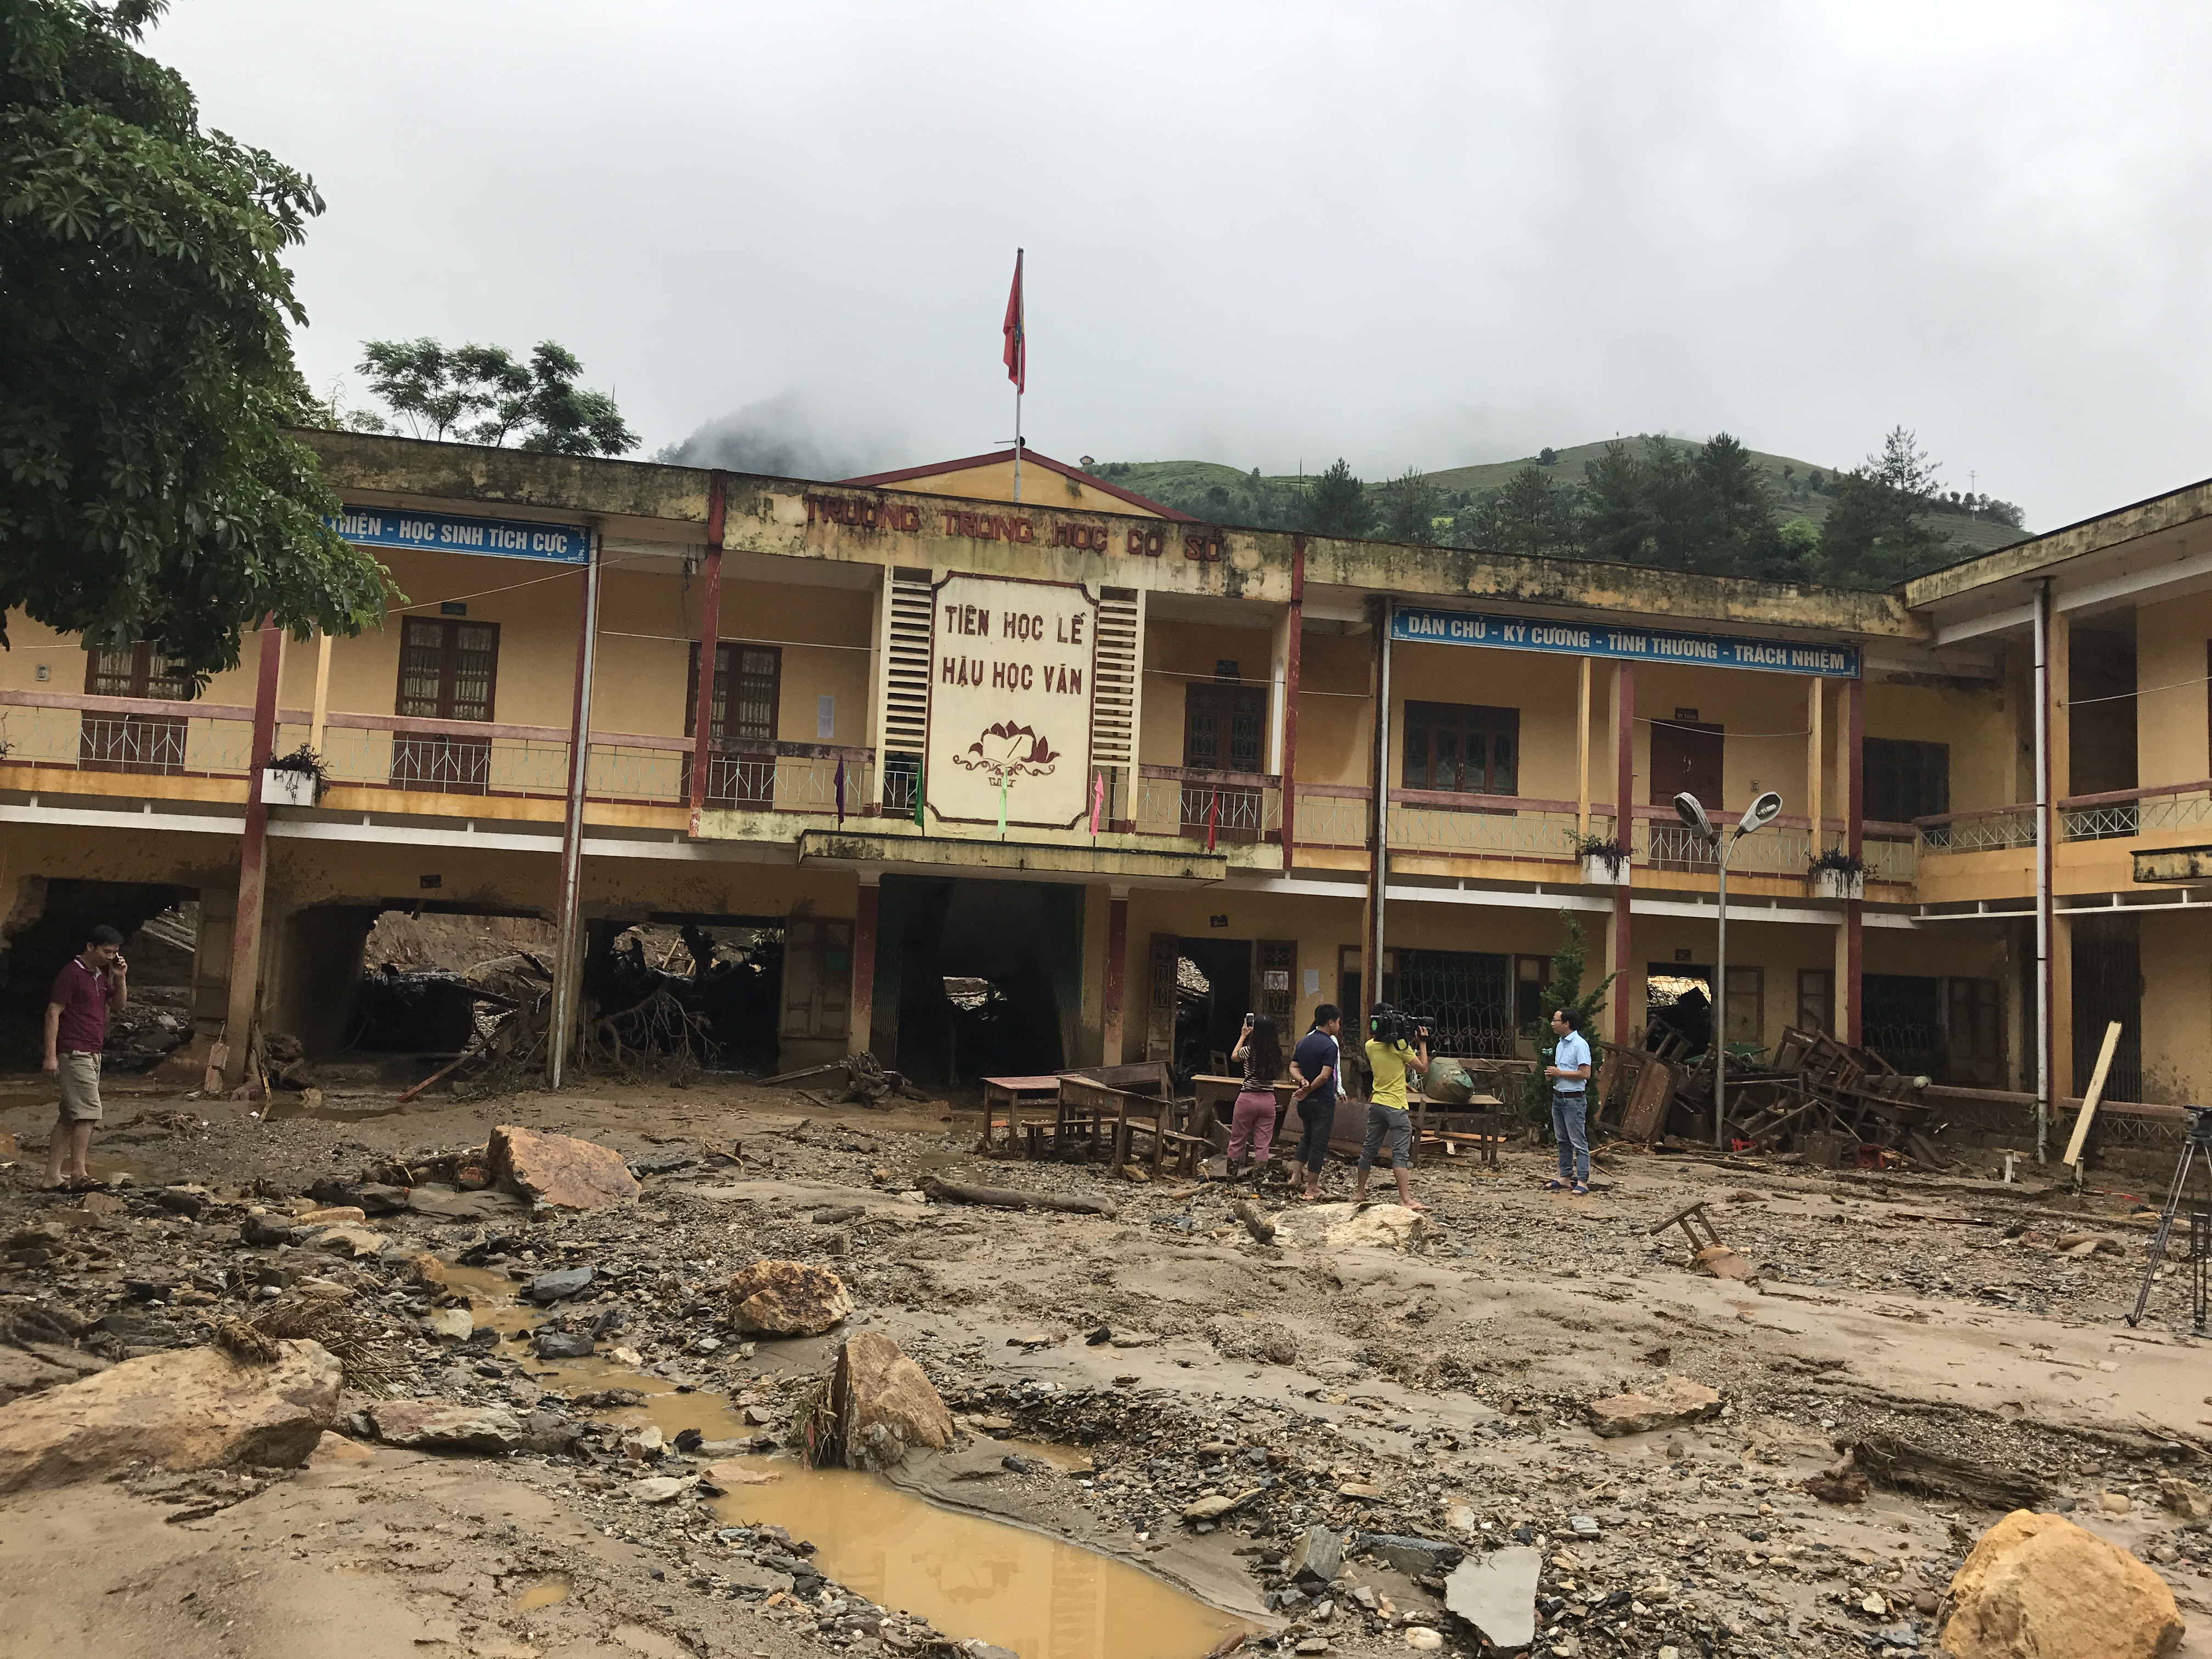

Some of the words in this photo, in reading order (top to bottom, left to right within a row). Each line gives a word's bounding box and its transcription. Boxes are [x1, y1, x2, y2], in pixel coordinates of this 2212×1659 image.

[399, 521, 435, 544] HỌC
[441, 524, 483, 546] SINH
[489, 525, 527, 550] TÍCH
[533, 533, 568, 556] CỰC
[941, 509, 1033, 543] TRUNG
[1003, 612, 1043, 642] HỌC
[1408, 614, 1444, 636] DÂN
[1451, 616, 1487, 640] CHỦ
[1504, 621, 1526, 643] KỶ
[1531, 627, 1590, 648] CƯƠNG
[1607, 630, 1646, 653] TÌNH
[1651, 636, 1718, 660] THƯƠNG
[1734, 641, 1786, 665] TRÁCH
[1791, 647, 1844, 672] NHIỆM
[992, 661, 1032, 692] HỌC
[1044, 664, 1082, 694] VĂN
